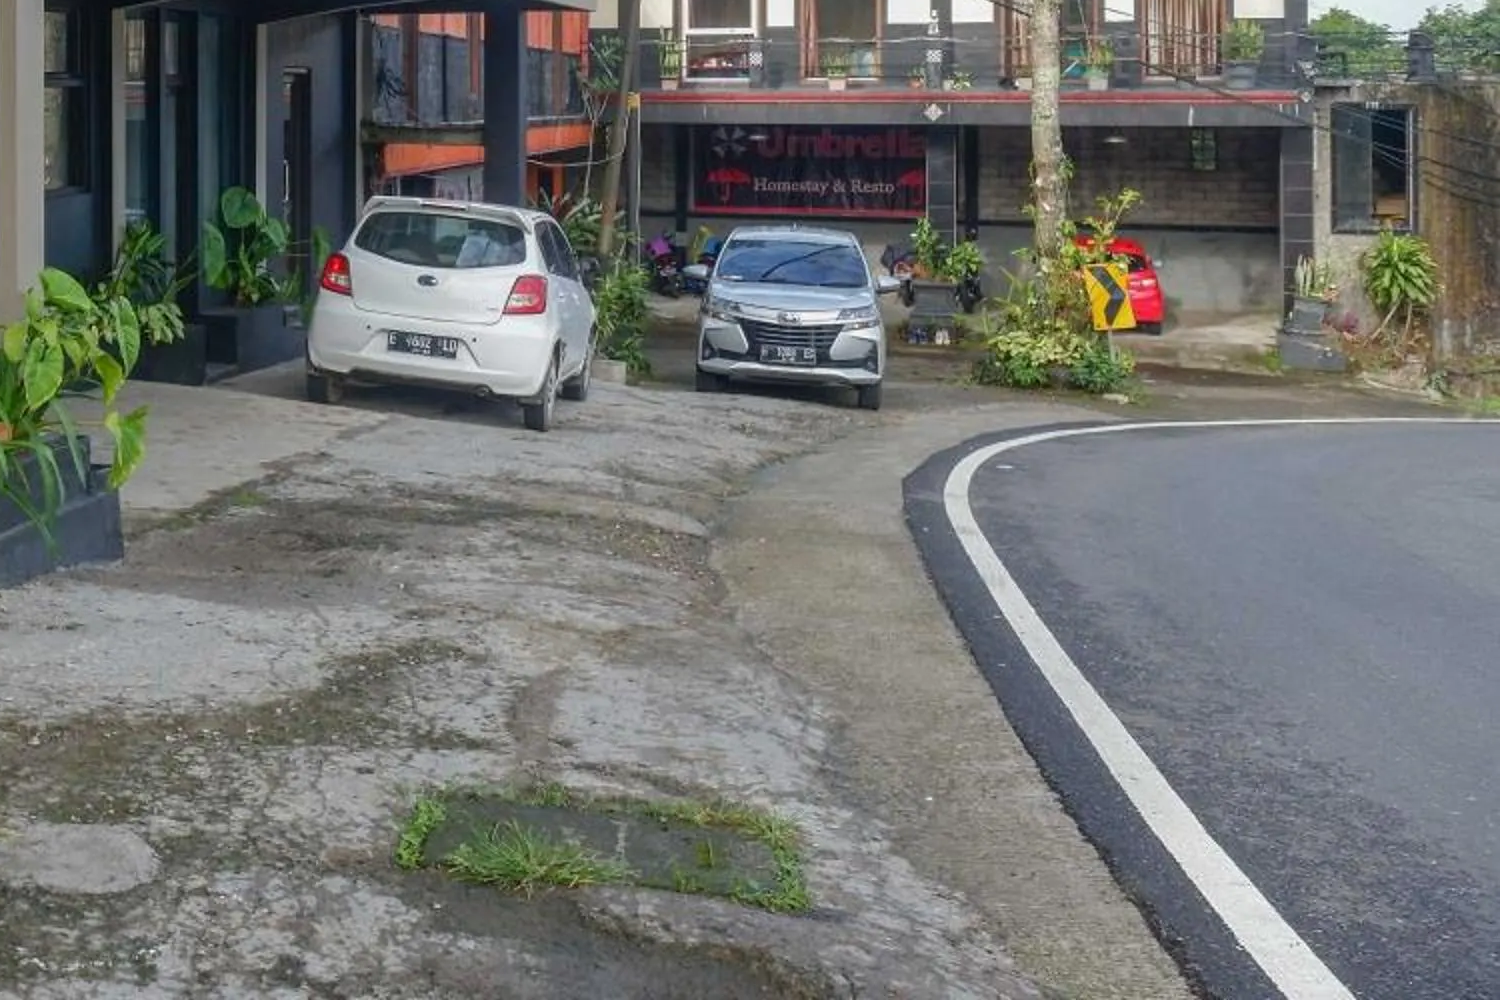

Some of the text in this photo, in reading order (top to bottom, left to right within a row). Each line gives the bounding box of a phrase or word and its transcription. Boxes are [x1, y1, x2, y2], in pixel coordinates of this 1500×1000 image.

[754, 177, 895, 195] Homestay & Resto
